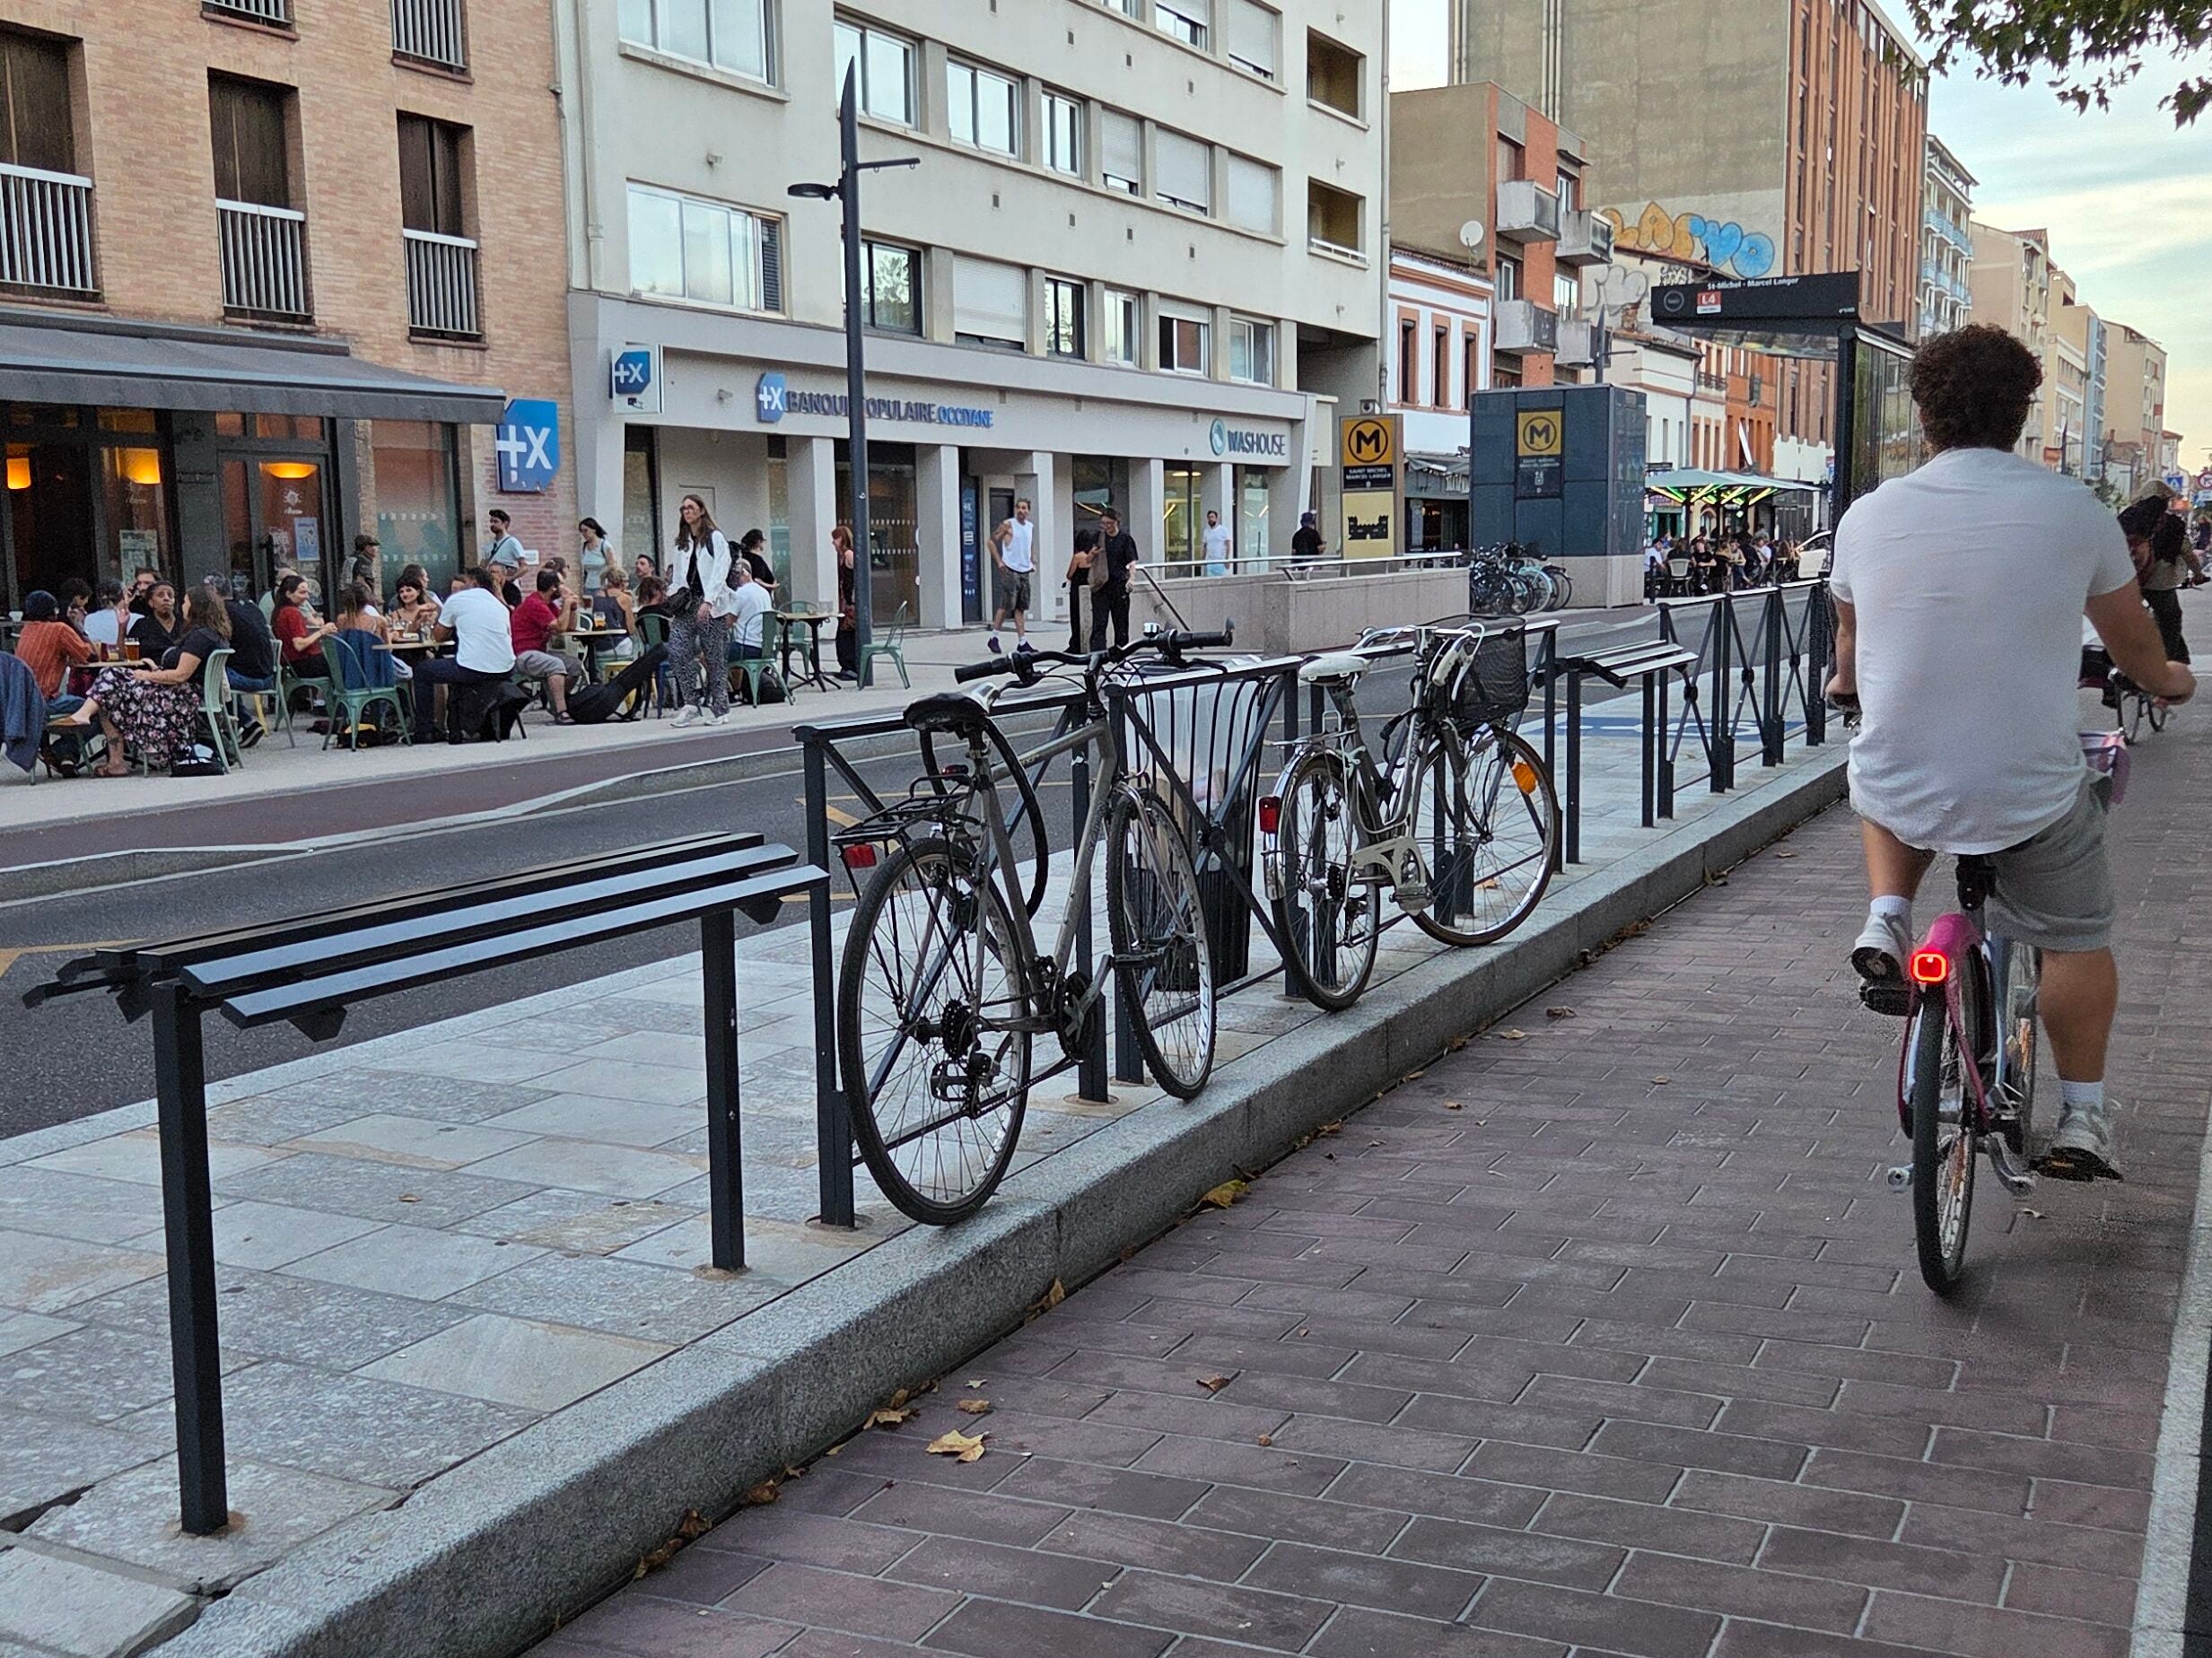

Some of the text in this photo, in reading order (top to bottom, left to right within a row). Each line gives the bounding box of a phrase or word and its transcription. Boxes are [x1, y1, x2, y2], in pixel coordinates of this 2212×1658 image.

[1746, 278, 1772, 288] Marcel
[1773, 276, 1799, 286] Langer
[1701, 292, 1716, 305] L4
[786, 391, 993, 428] BANQU OPULAIRE OCCITANE
[1227, 431, 1286, 456] WASHOUSE
[1356, 429, 1380, 454] M
[1529, 423, 1551, 444] M
